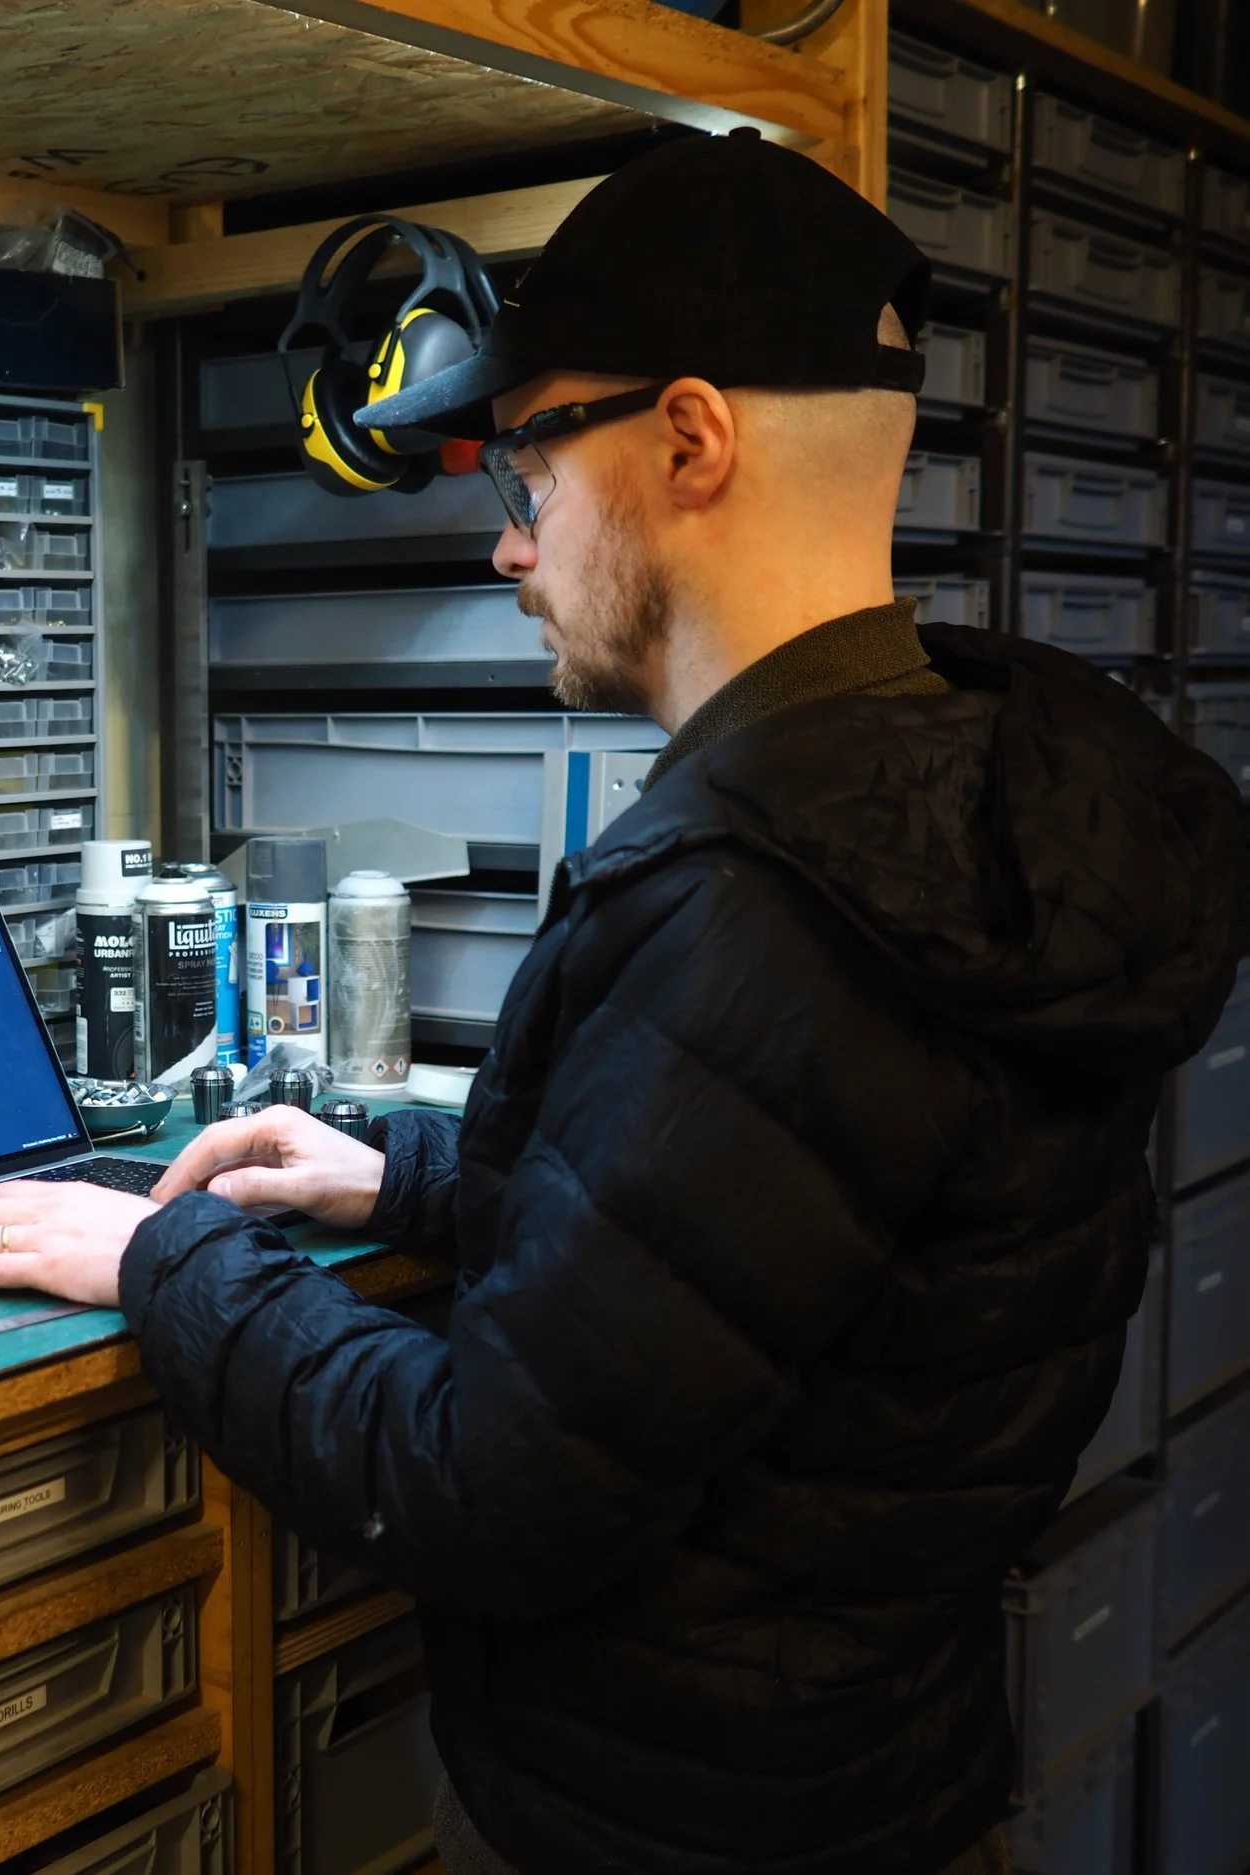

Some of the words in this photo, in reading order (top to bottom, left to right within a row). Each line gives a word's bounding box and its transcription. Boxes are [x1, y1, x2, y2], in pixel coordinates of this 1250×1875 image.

[250, 908, 287, 918] LUXENS
[168, 918, 217, 951] Liquit
[177, 959, 206, 970] SPRAY
[24, 1489, 52, 1506] TOOLS
